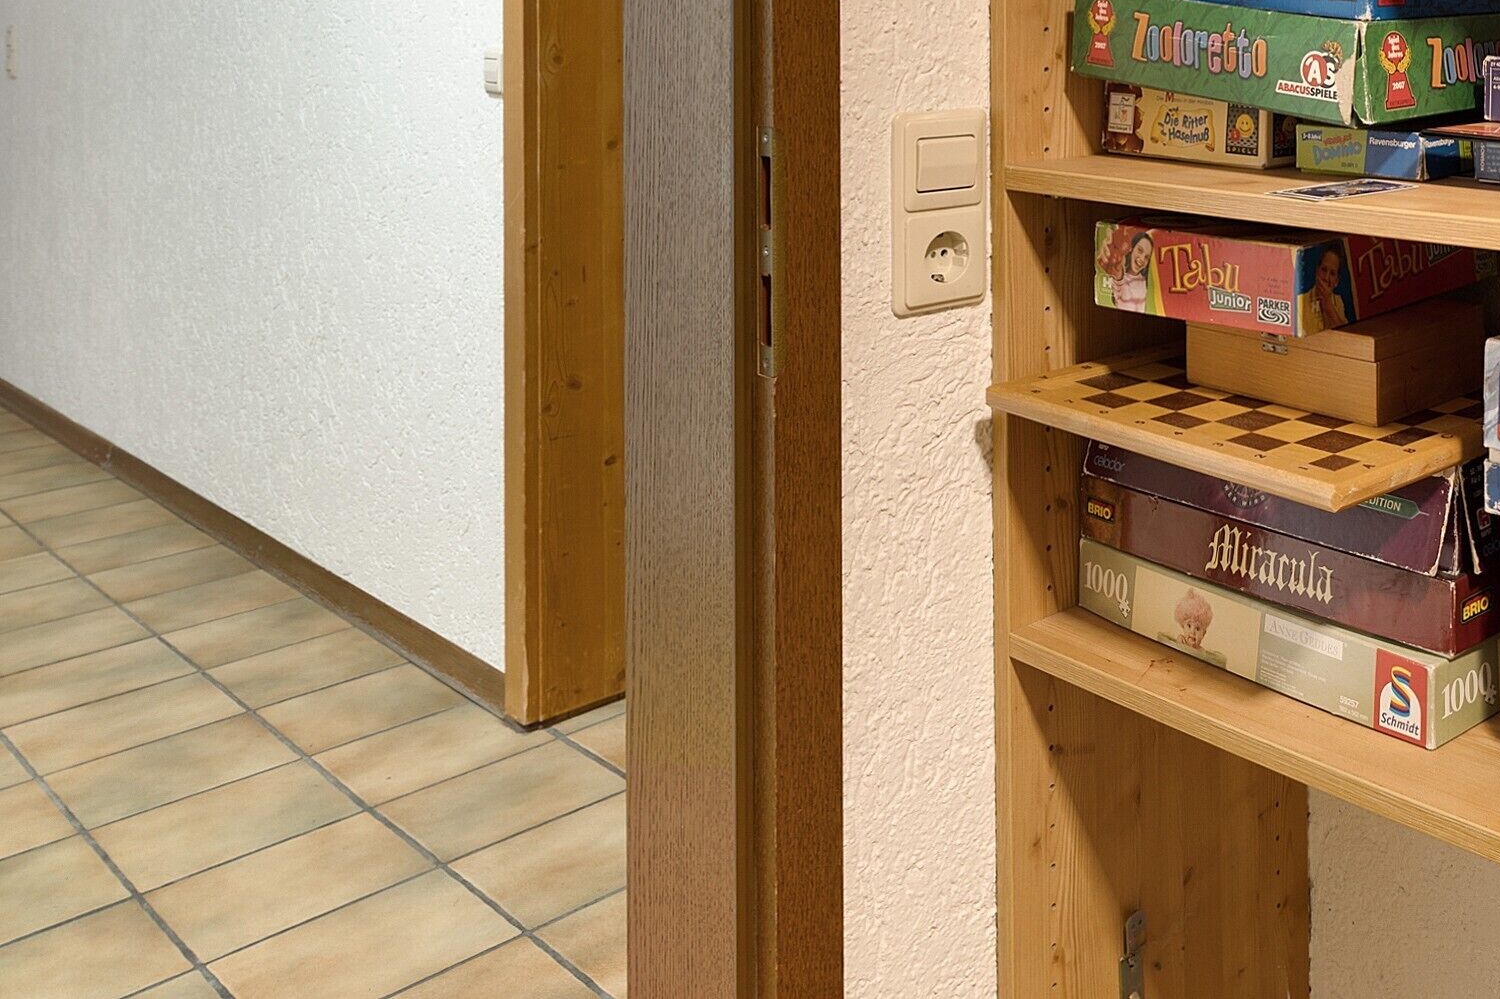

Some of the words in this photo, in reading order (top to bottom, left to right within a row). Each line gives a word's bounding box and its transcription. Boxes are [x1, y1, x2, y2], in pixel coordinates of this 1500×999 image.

[1132, 11, 1268, 80] Zooloretto
[1278, 80, 1337, 100] ABACUSSPIELE
[1164, 112, 1179, 126] Die
[1182, 114, 1208, 128] Ritter
[1168, 127, 1209, 143] Haselnuß
[1369, 137, 1416, 149] Ravensburger
[1160, 242, 1240, 294] Tabu
[1210, 288, 1252, 312] Junior
[1258, 298, 1290, 313] PARKER
[1087, 501, 1112, 520] BRIO
[1205, 523, 1334, 605] Miracula
[1462, 594, 1489, 619] BRIO
[1380, 712, 1420, 737] Schmidt
